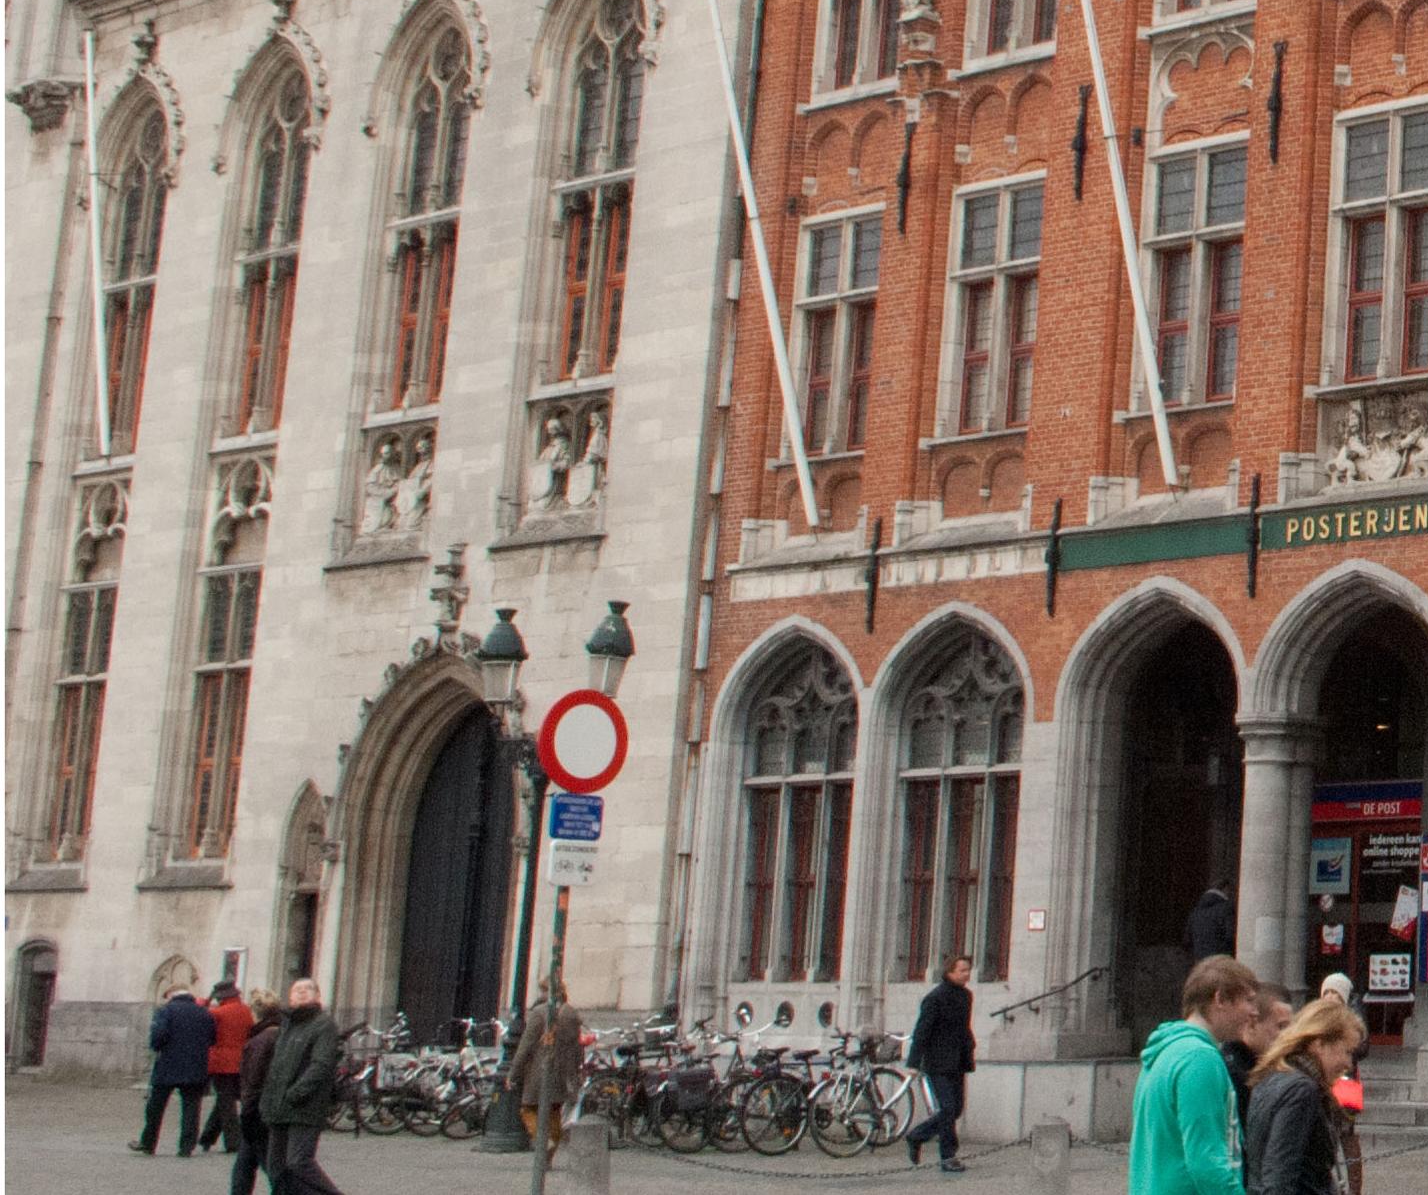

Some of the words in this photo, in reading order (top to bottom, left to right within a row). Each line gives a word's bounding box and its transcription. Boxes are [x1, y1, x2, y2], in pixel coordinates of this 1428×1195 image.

[1363, 803, 1377, 815] DE
[1377, 802, 1402, 814] POST
[1369, 834, 1405, 845] iedereen
[1363, 847, 1388, 856] online
[1390, 846, 1420, 858] shoppe
